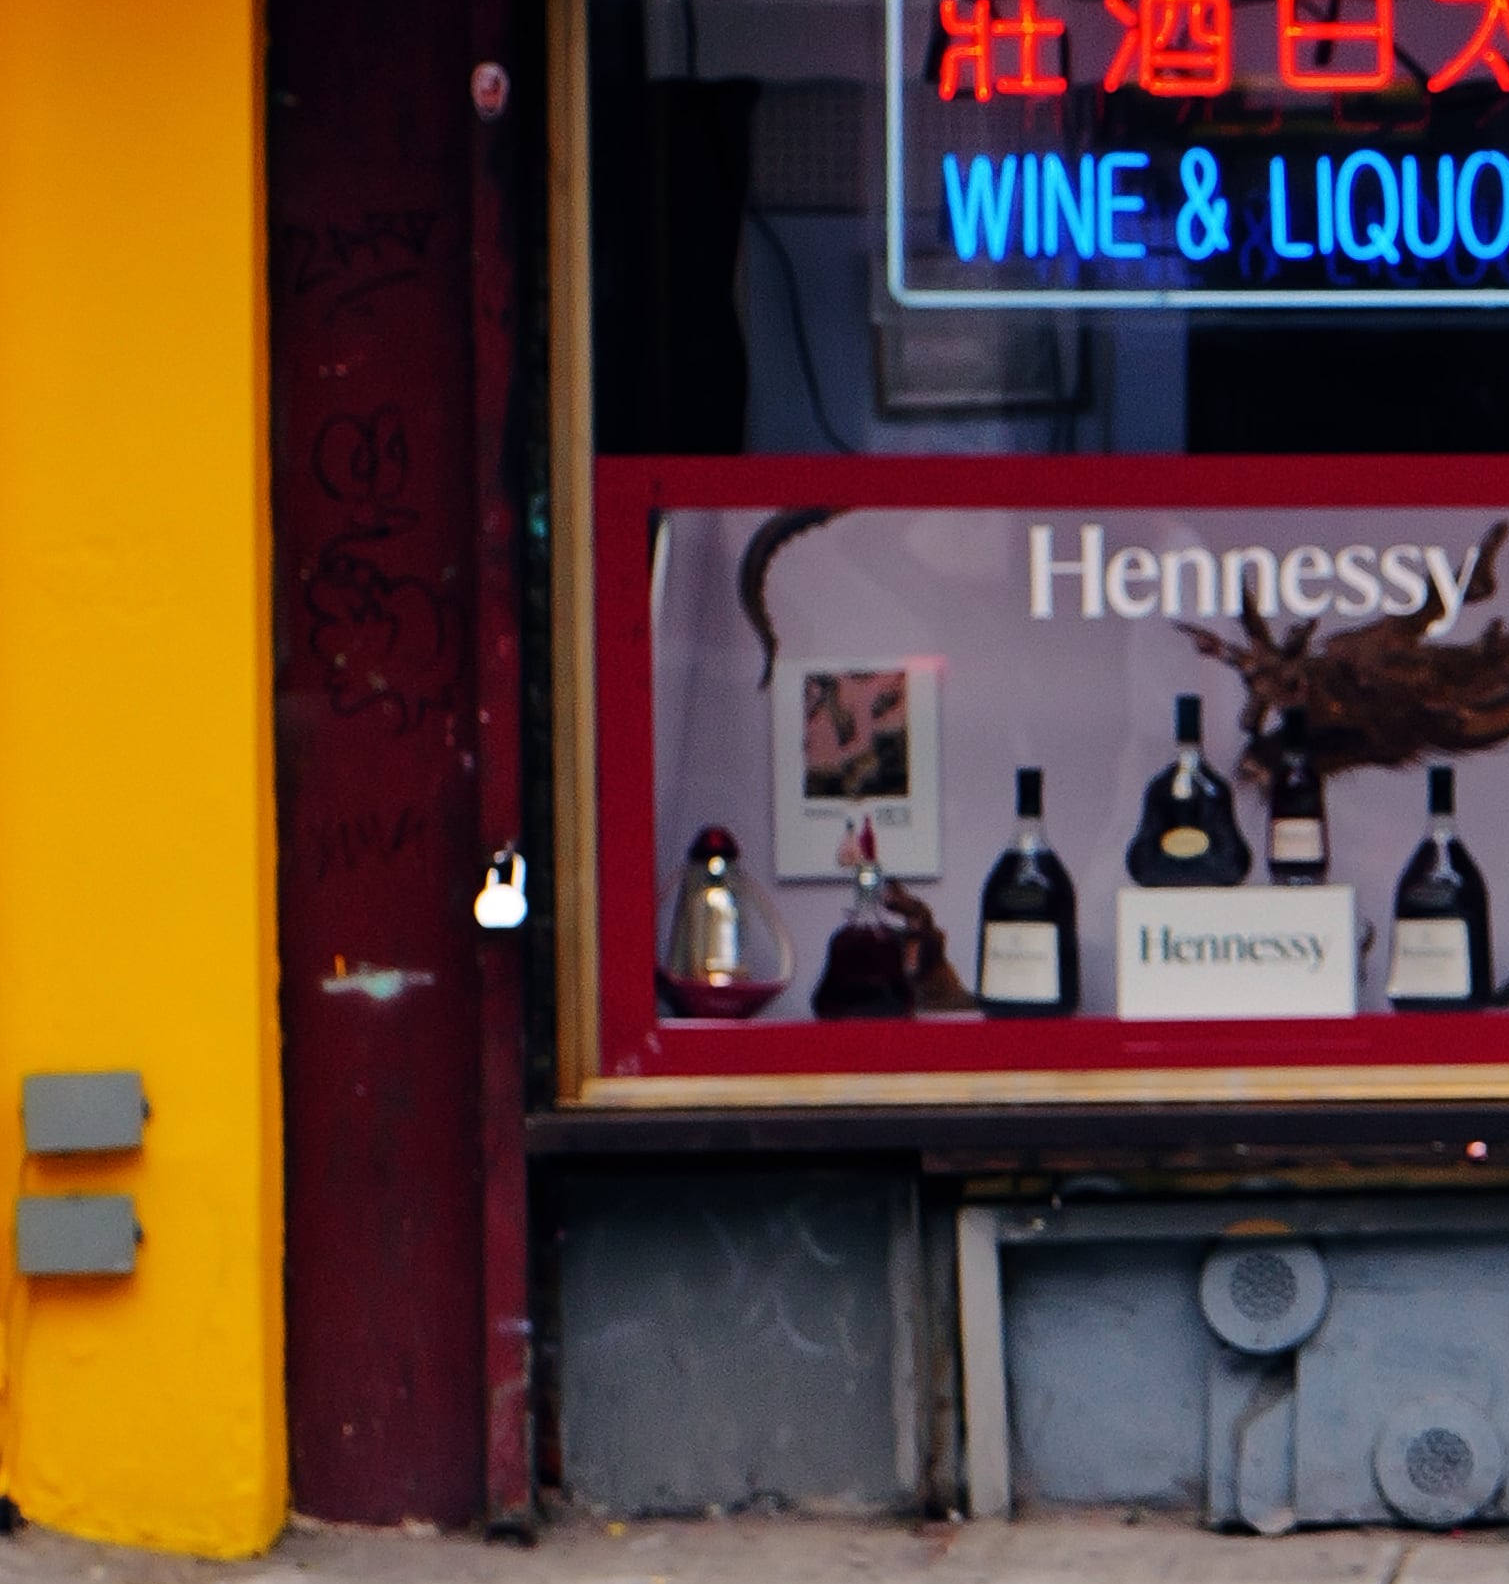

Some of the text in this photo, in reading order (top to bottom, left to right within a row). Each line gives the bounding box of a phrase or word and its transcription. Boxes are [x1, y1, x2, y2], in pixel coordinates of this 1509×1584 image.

[942, 151, 1151, 263] WINE
[1174, 146, 1232, 262] &
[1029, 524, 1479, 639] Hennessy
[1138, 923, 1328, 975] Hennessy
